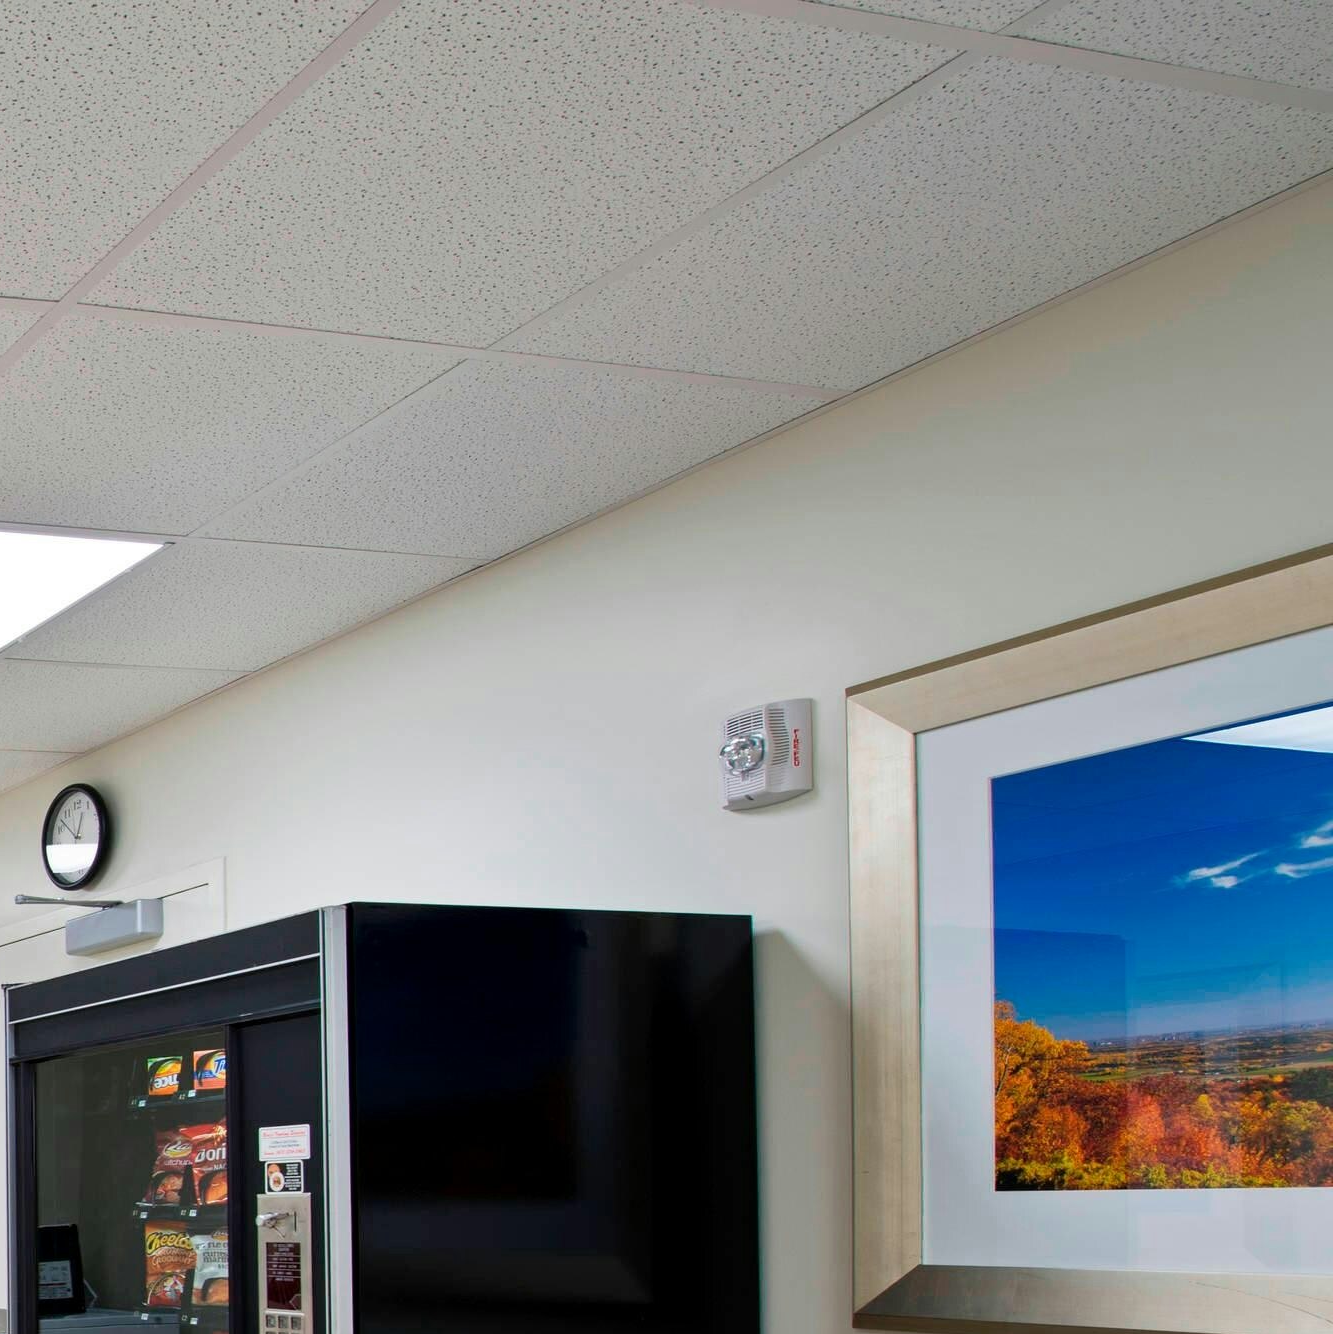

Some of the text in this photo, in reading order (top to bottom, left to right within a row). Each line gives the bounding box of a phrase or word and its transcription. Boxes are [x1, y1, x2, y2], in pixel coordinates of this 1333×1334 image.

[74, 800, 81, 810] 12
[64, 809, 71, 819] 11
[195, 1143, 226, 1163] Dori
